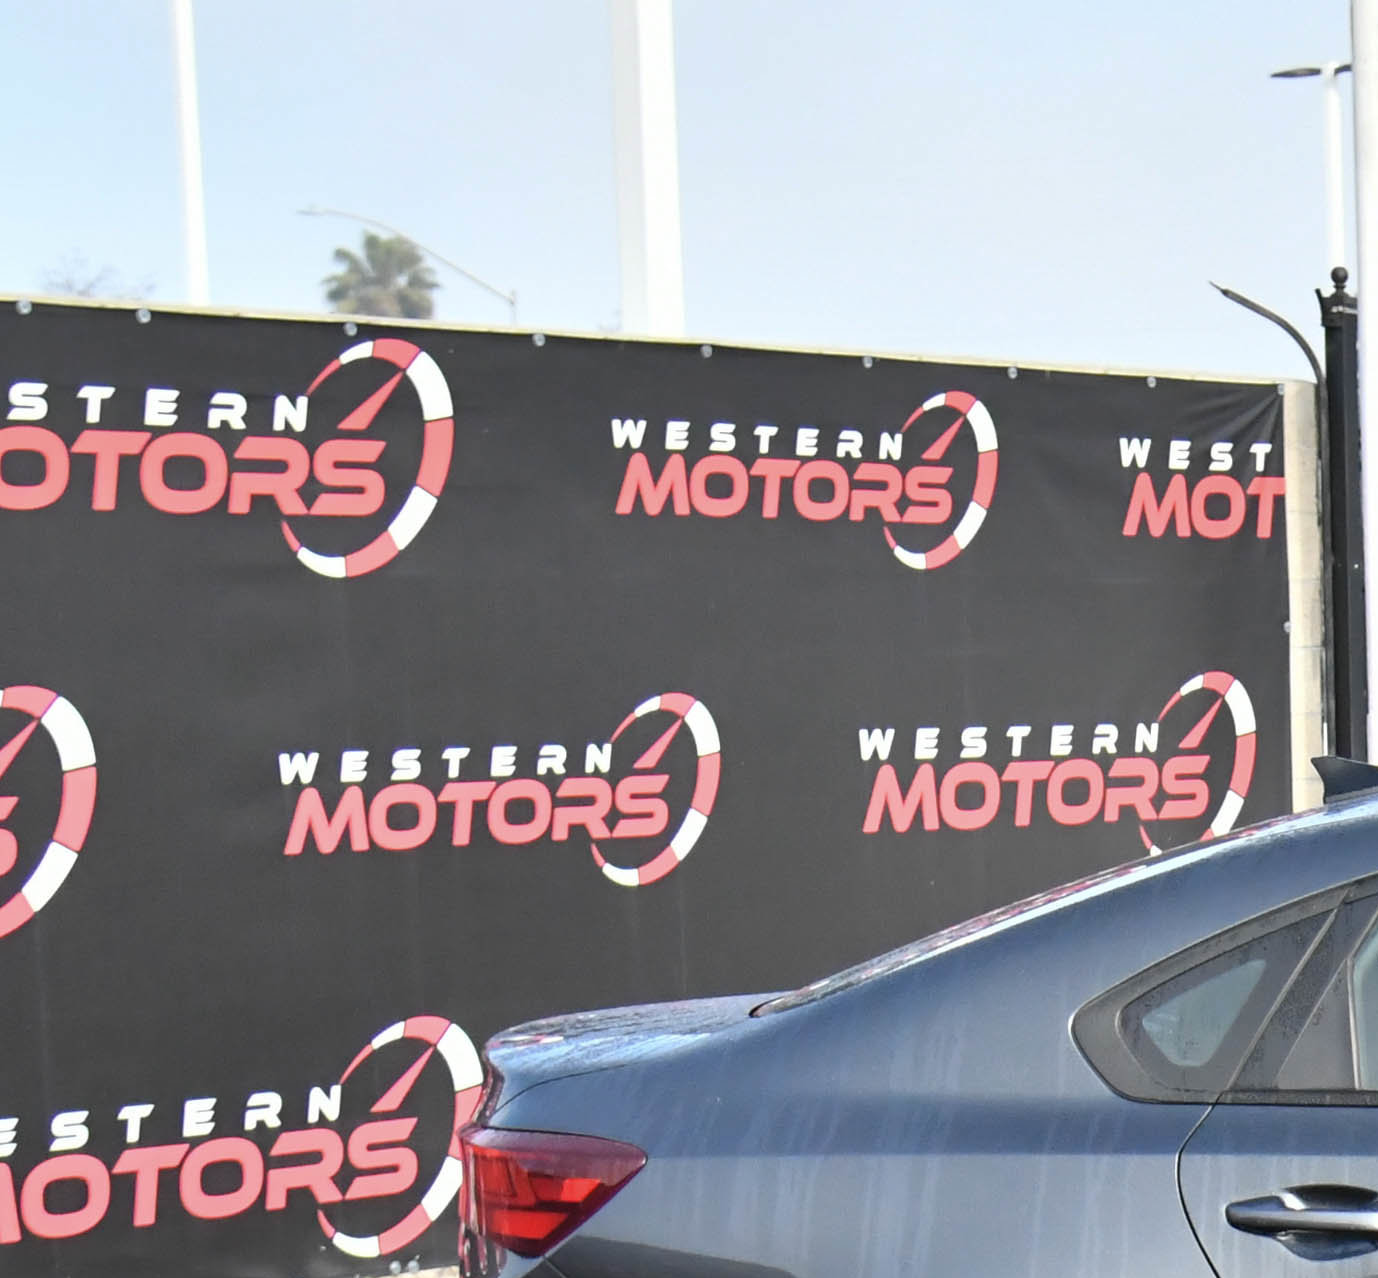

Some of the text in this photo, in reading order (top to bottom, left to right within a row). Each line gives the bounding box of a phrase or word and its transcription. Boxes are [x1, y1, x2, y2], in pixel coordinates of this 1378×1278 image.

[611, 419, 903, 460] WESTERN
[1119, 438, 1273, 471] WEST
[615, 452, 953, 524] MOTORS
[1122, 472, 1287, 539] MOT
[278, 744, 612, 785] WESTERN
[859, 723, 1160, 761] WESTERN
[284, 774, 670, 856] MOTORS
[862, 755, 1211, 834] MOTORS
[0, 1118, 418, 1244] OTORS
